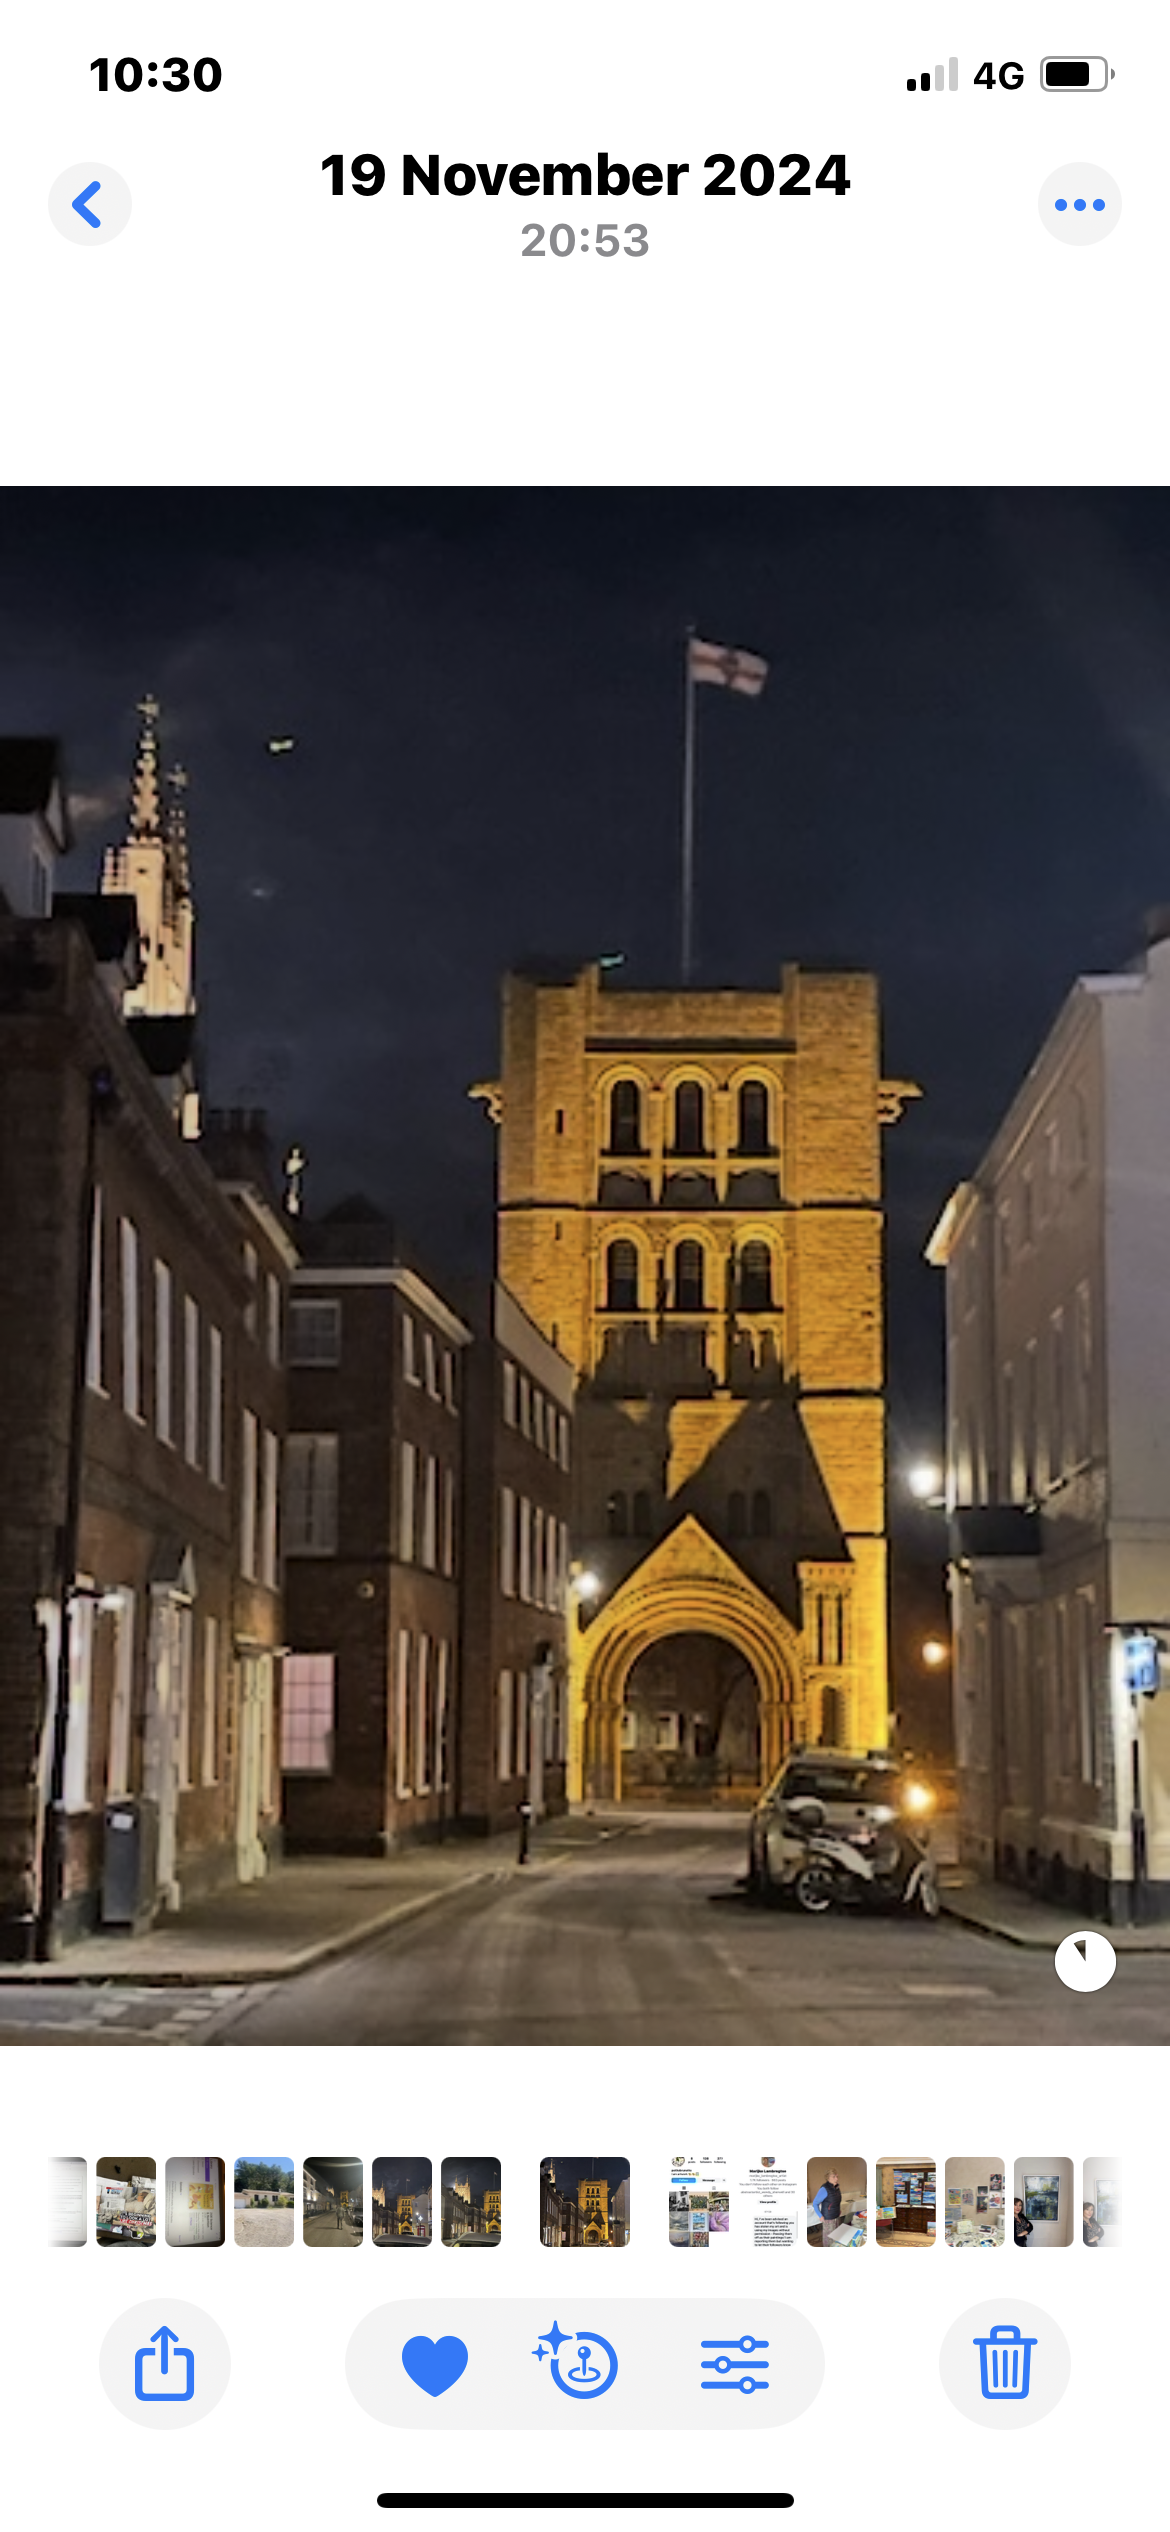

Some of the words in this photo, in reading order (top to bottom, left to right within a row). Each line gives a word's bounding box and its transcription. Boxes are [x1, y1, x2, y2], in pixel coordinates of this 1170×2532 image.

[89, 57, 222, 92] 10:30
[974, 61, 1025, 91] 4G
[322, 152, 386, 197] 19
[402, 151, 690, 197] November
[703, 152, 852, 197] 2024
[521, 222, 649, 258] 20:53
